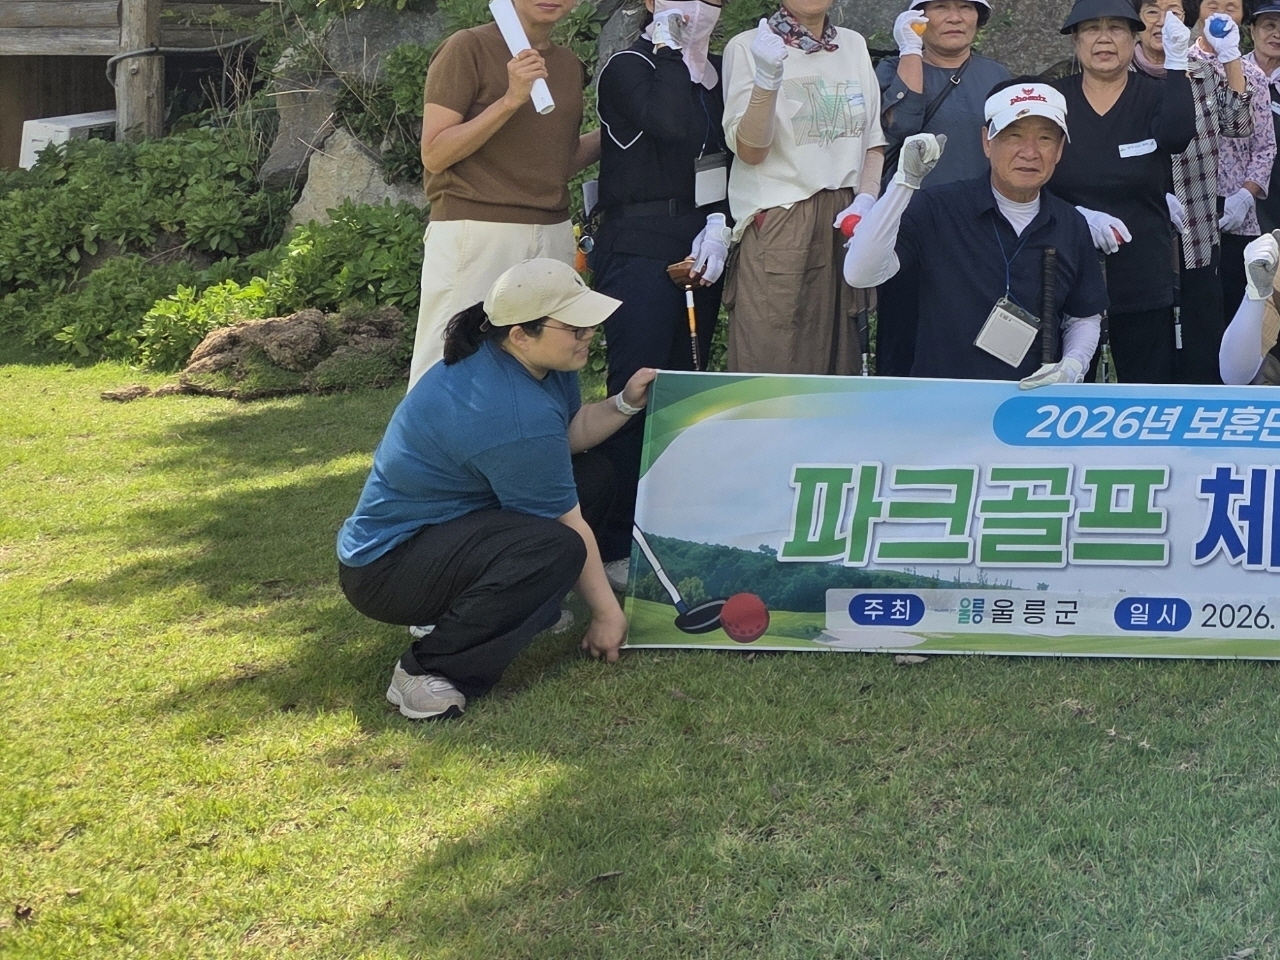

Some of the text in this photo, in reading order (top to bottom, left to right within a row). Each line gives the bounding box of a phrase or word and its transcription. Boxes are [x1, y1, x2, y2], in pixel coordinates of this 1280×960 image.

[1010, 93, 1048, 106] phoenix
[1026, 405, 1183, 440] 2026년
[778, 461, 1169, 567] 파크골프
[863, 599, 911, 621] 주최
[991, 599, 1079, 626] 울릉군
[1130, 603, 1177, 626] 일시
[1201, 603, 1275, 629] 2026.
